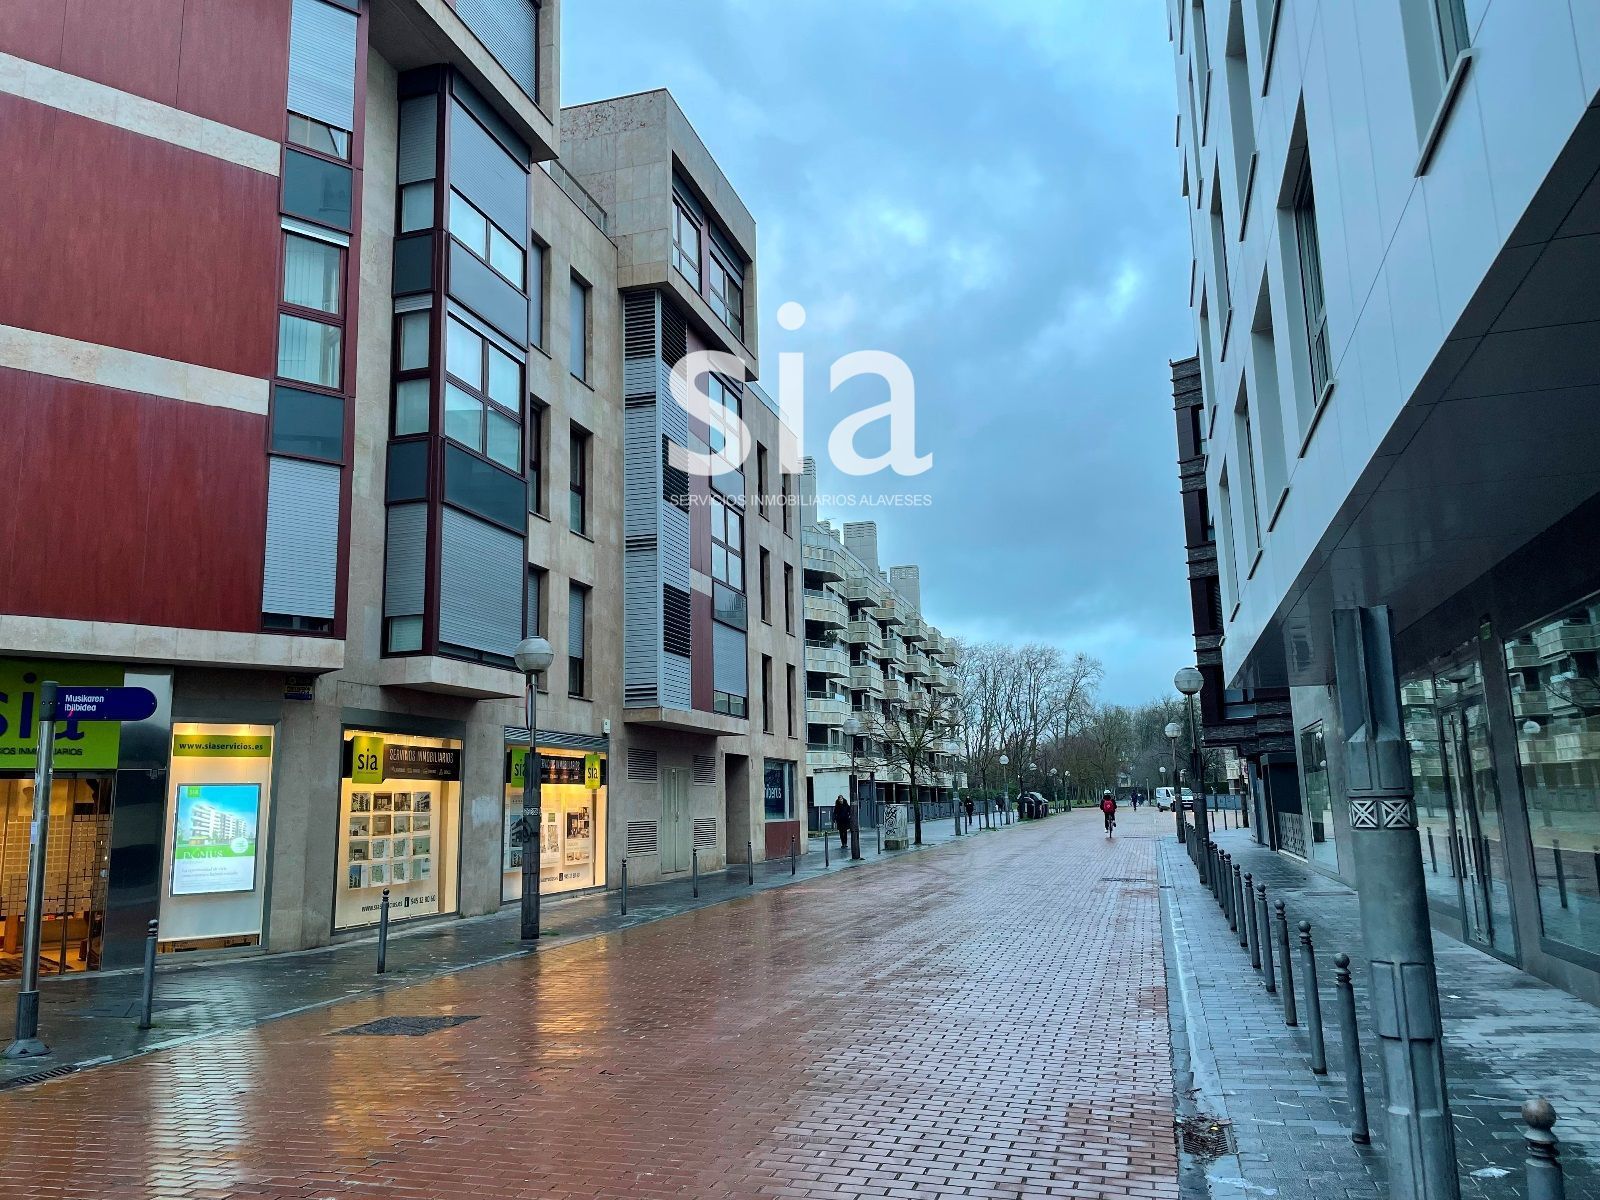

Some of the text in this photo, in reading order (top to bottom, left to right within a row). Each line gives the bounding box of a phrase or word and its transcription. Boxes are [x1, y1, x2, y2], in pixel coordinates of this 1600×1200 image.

[65, 694, 105, 703] Musikaren
[64, 703, 97, 712] ibilbidea
[178, 742, 264, 751] www.siaservicios.es
[357, 748, 379, 771] sia
[587, 763, 599, 779] sia
